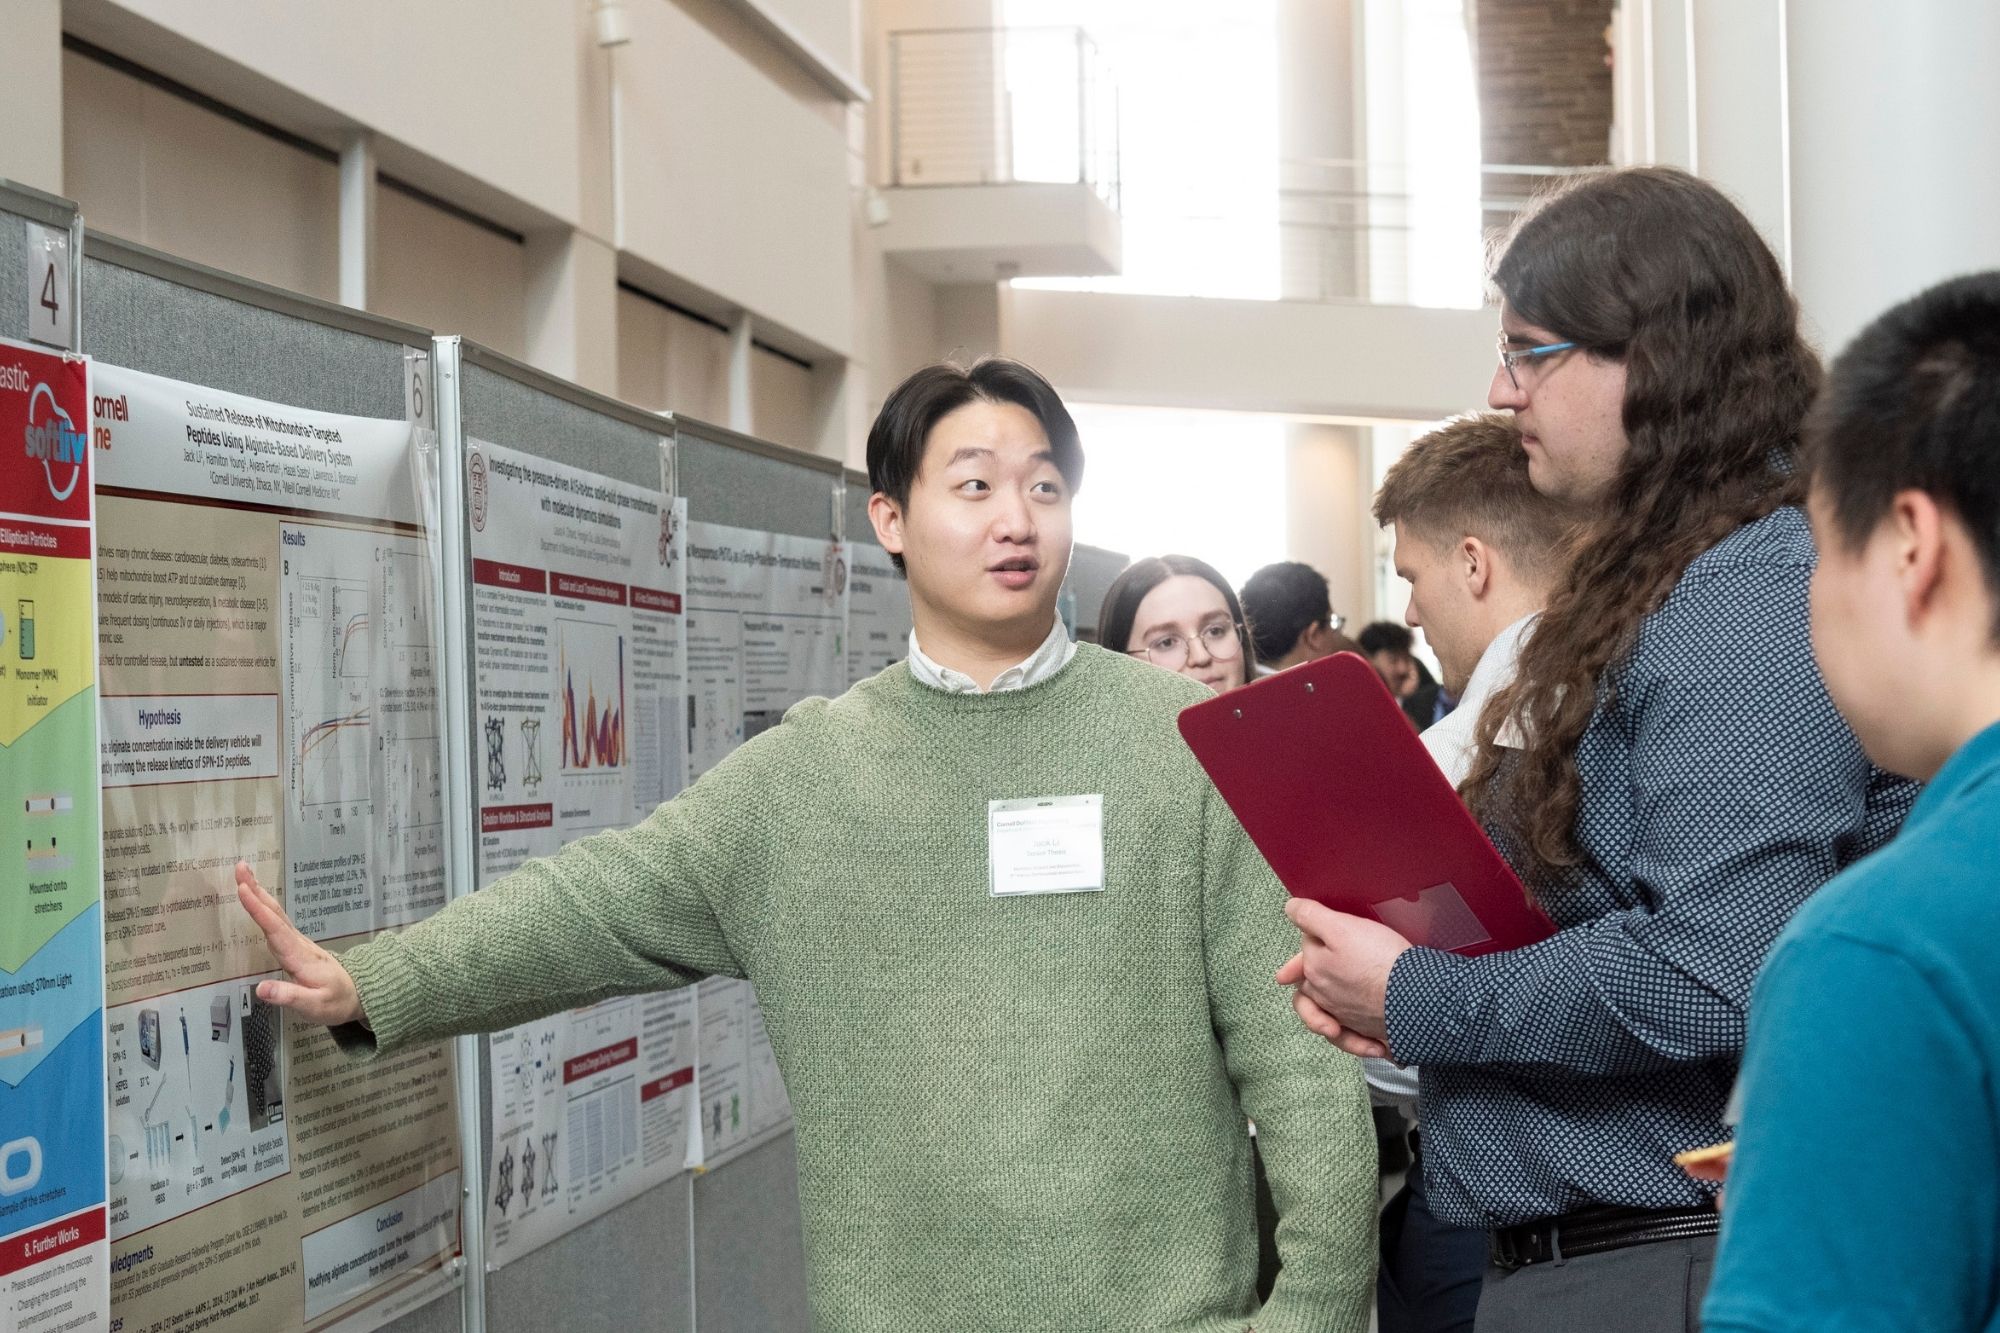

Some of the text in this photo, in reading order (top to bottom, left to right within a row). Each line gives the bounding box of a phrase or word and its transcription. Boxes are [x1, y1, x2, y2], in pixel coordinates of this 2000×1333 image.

[41, 263, 59, 325] 4
[0, 362, 30, 392] astic
[412, 372, 425, 418] 6
[94, 395, 129, 422] ornell
[186, 401, 342, 442] Sustained Release of Mitochondria-Targeted
[186, 425, 353, 466] Peptides Using Alginate-Based Delivery System
[489, 455, 523, 484] Investigating
[30, 531, 57, 548] Particles
[282, 529, 306, 548] Results
[131, 549, 150, 560] chronic
[284, 560, 289, 576] B
[138, 708, 182, 729] Hypothesis
[132, 738, 173, 752] concentration
[174, 737, 194, 750] inside
[195, 736, 205, 749] the
[206, 736, 229, 750] delivery
[230, 735, 250, 748] vehicle
[136, 759, 146, 772] the
[147, 758, 168, 771] release
[170, 757, 194, 770] kinetics
[195, 756, 202, 768] of
[29, 880, 67, 894] Mounted onto
[34, 901, 62, 914] stretchers
[18, 980, 35, 996] using
[56, 974, 72, 989] Light
[243, 993, 248, 1010] A
[376, 1210, 403, 1232] Conclusion
[24, 1226, 79, 1257] 8. Further Works
